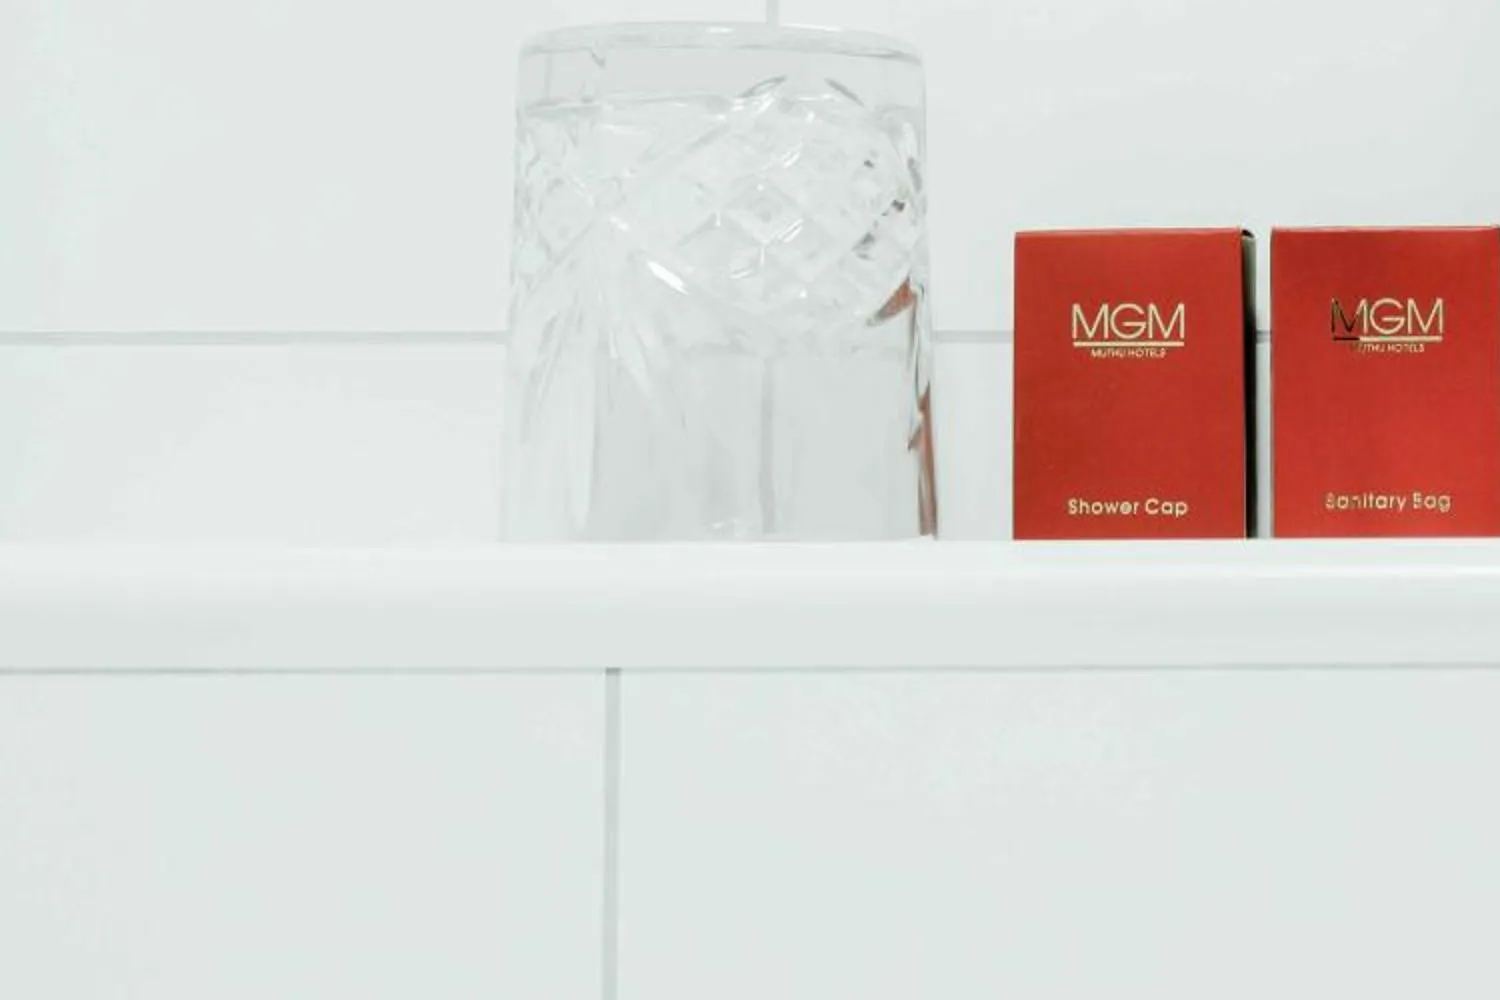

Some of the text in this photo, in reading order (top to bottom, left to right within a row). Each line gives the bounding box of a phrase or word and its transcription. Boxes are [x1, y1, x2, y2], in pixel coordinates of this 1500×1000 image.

[1071, 302, 1186, 340] MGM
[1330, 298, 1444, 335] MGM
[1067, 497, 1189, 518] Shower Cap
[1325, 491, 1452, 513] Sanitary Bag
